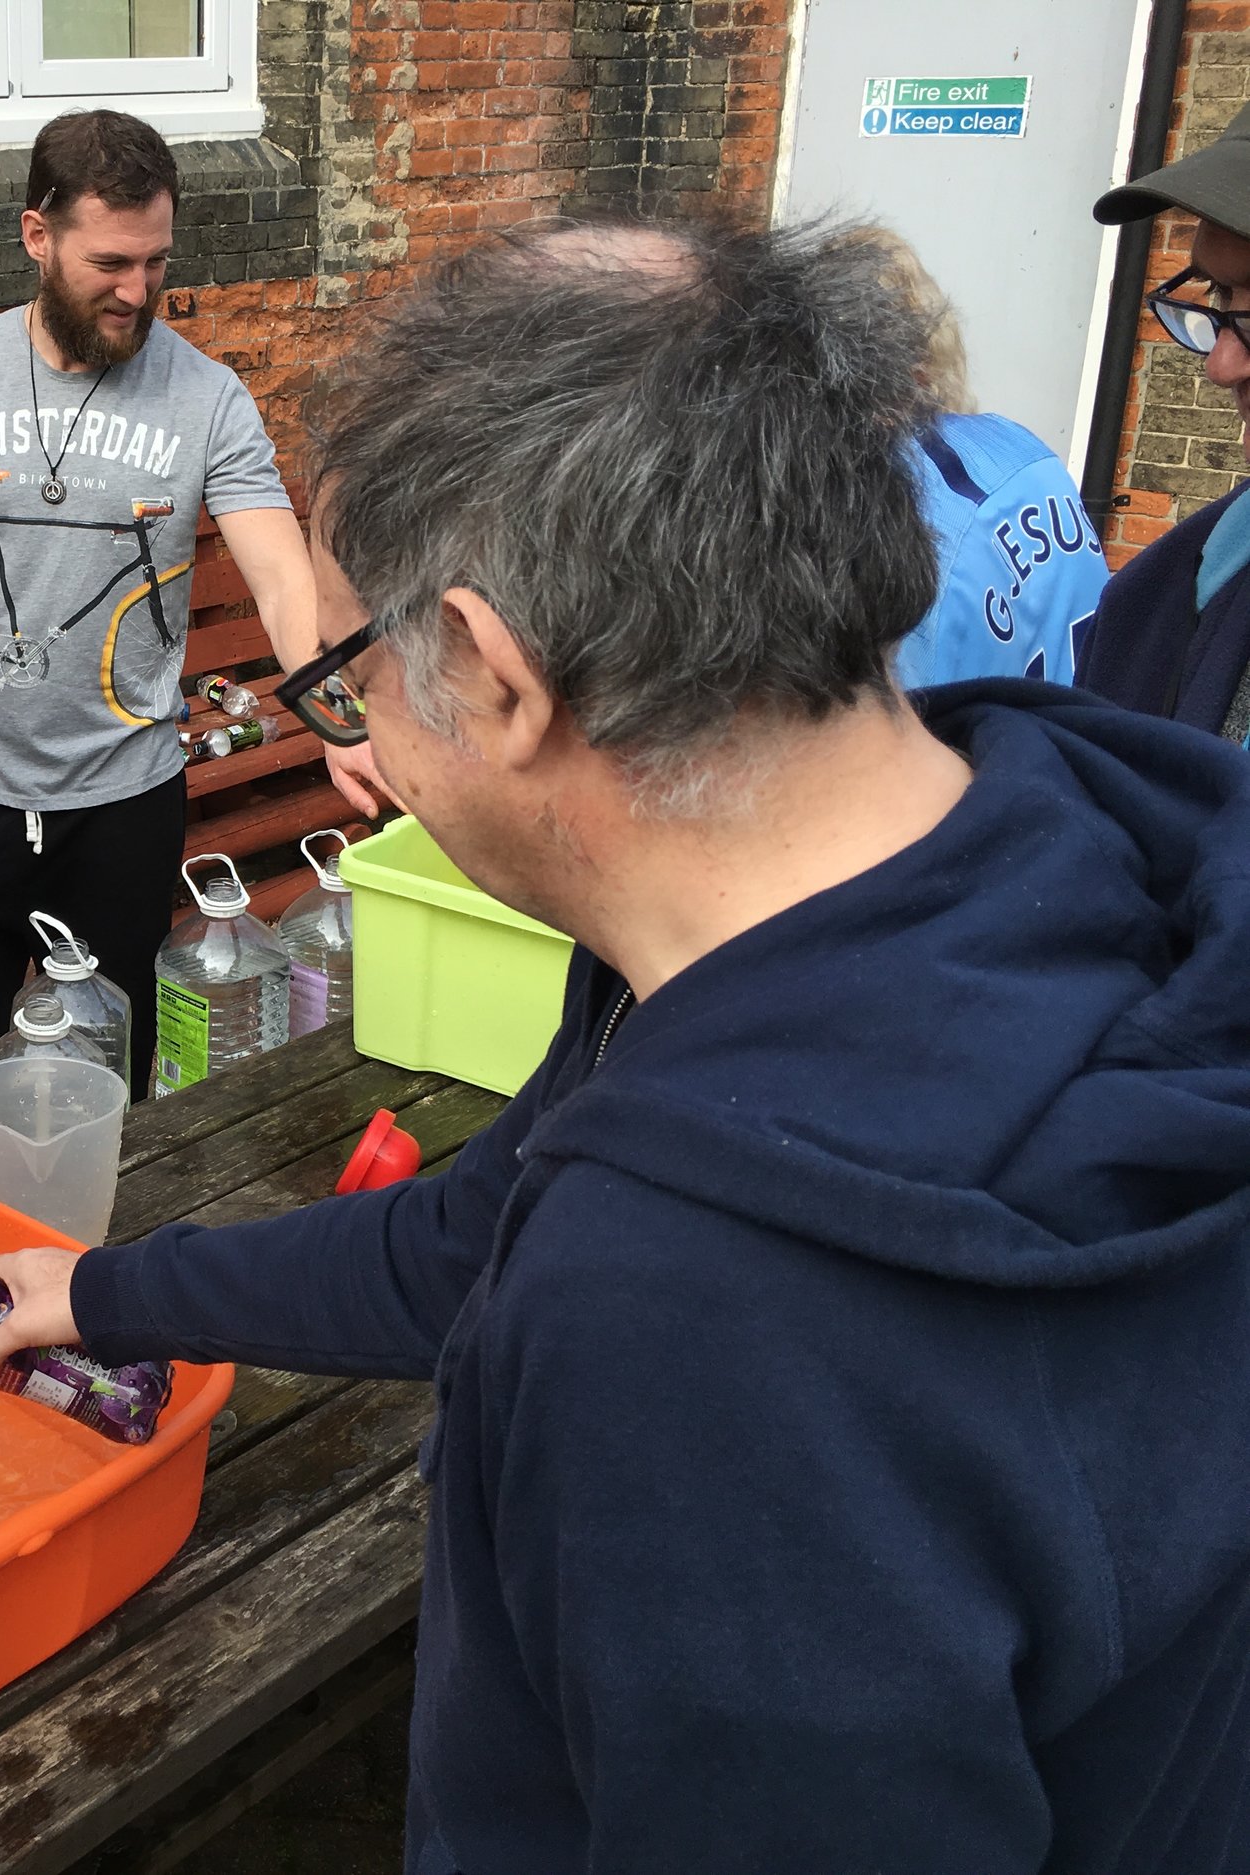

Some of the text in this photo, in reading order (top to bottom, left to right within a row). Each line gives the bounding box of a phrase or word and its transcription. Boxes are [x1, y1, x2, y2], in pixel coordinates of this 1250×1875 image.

[898, 83, 989, 101] Fire exit
[894, 112, 1016, 134] Keep clear
[19, 473, 106, 490] BIKTOWN
